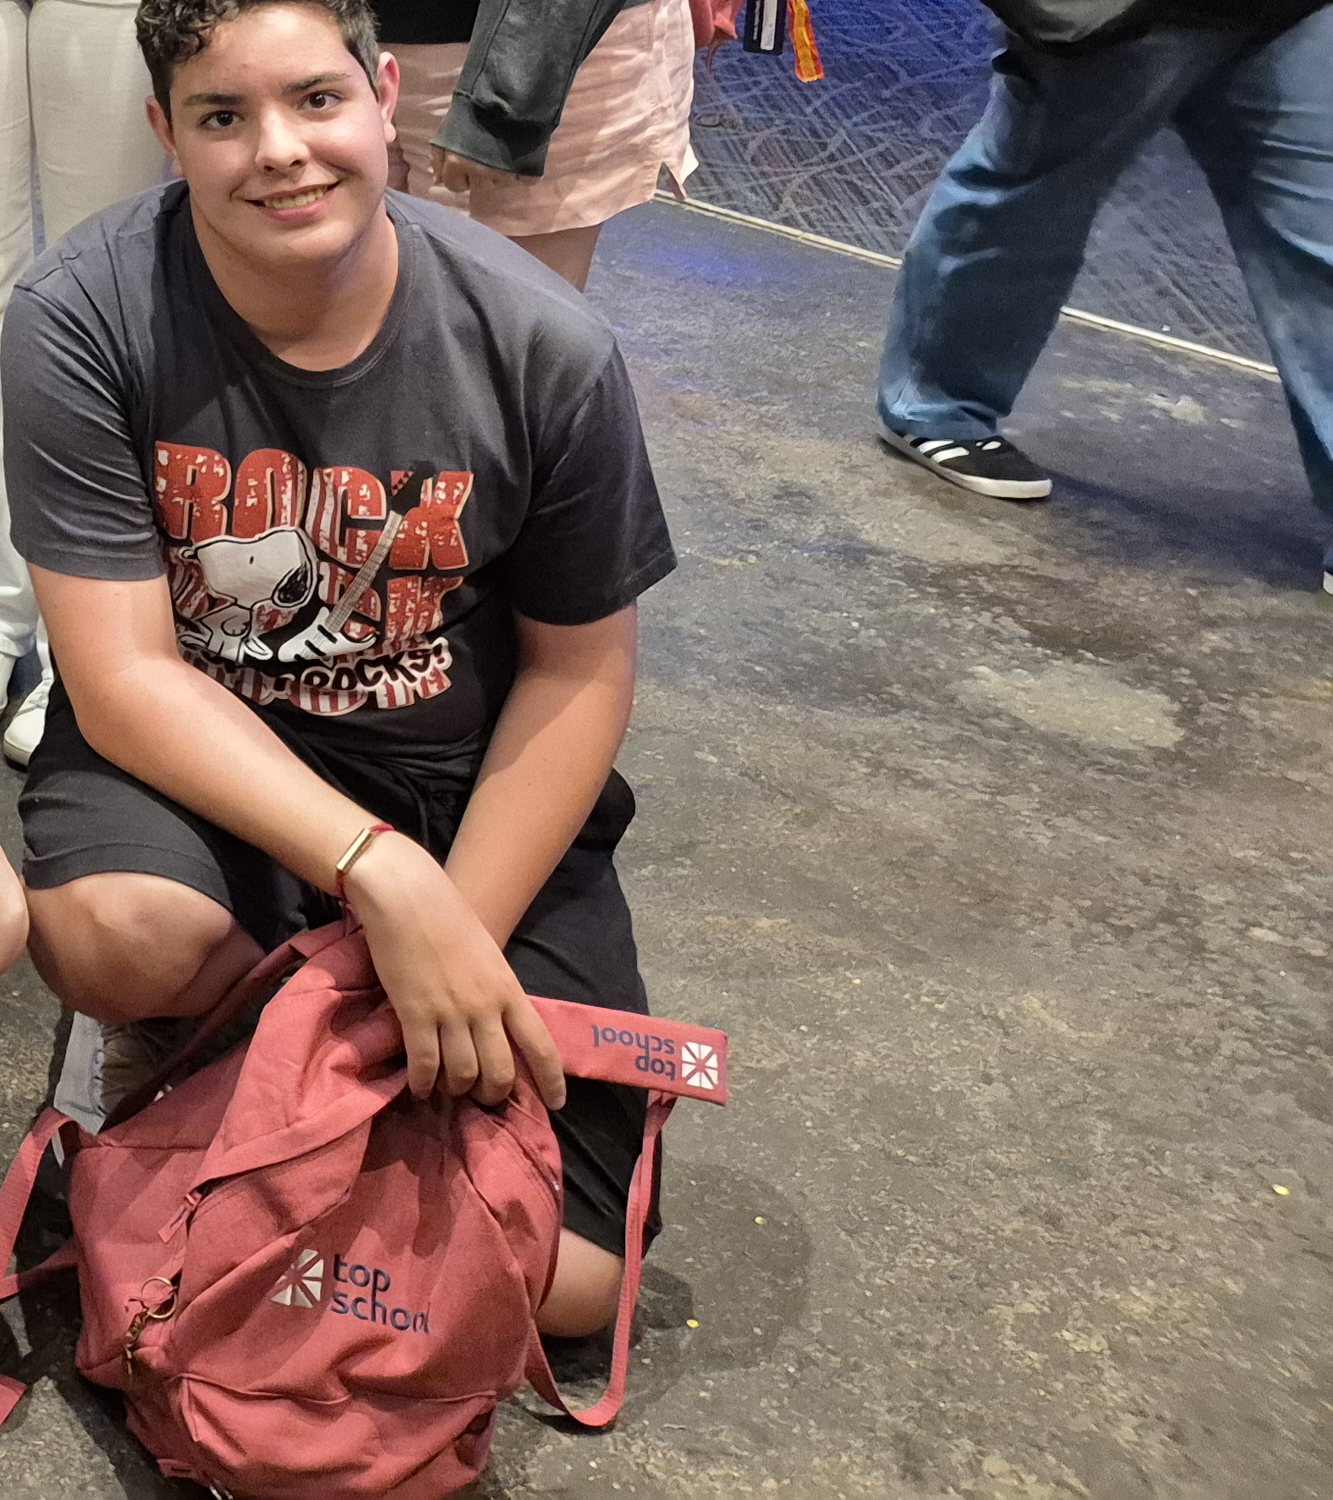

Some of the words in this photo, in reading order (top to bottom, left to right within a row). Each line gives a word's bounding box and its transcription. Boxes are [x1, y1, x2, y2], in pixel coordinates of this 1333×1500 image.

[153, 440, 475, 571] ROCK
[590, 1024, 677, 1056] school
[634, 1053, 677, 1081] top
[333, 1253, 392, 1297] top
[330, 1290, 431, 1337] school
